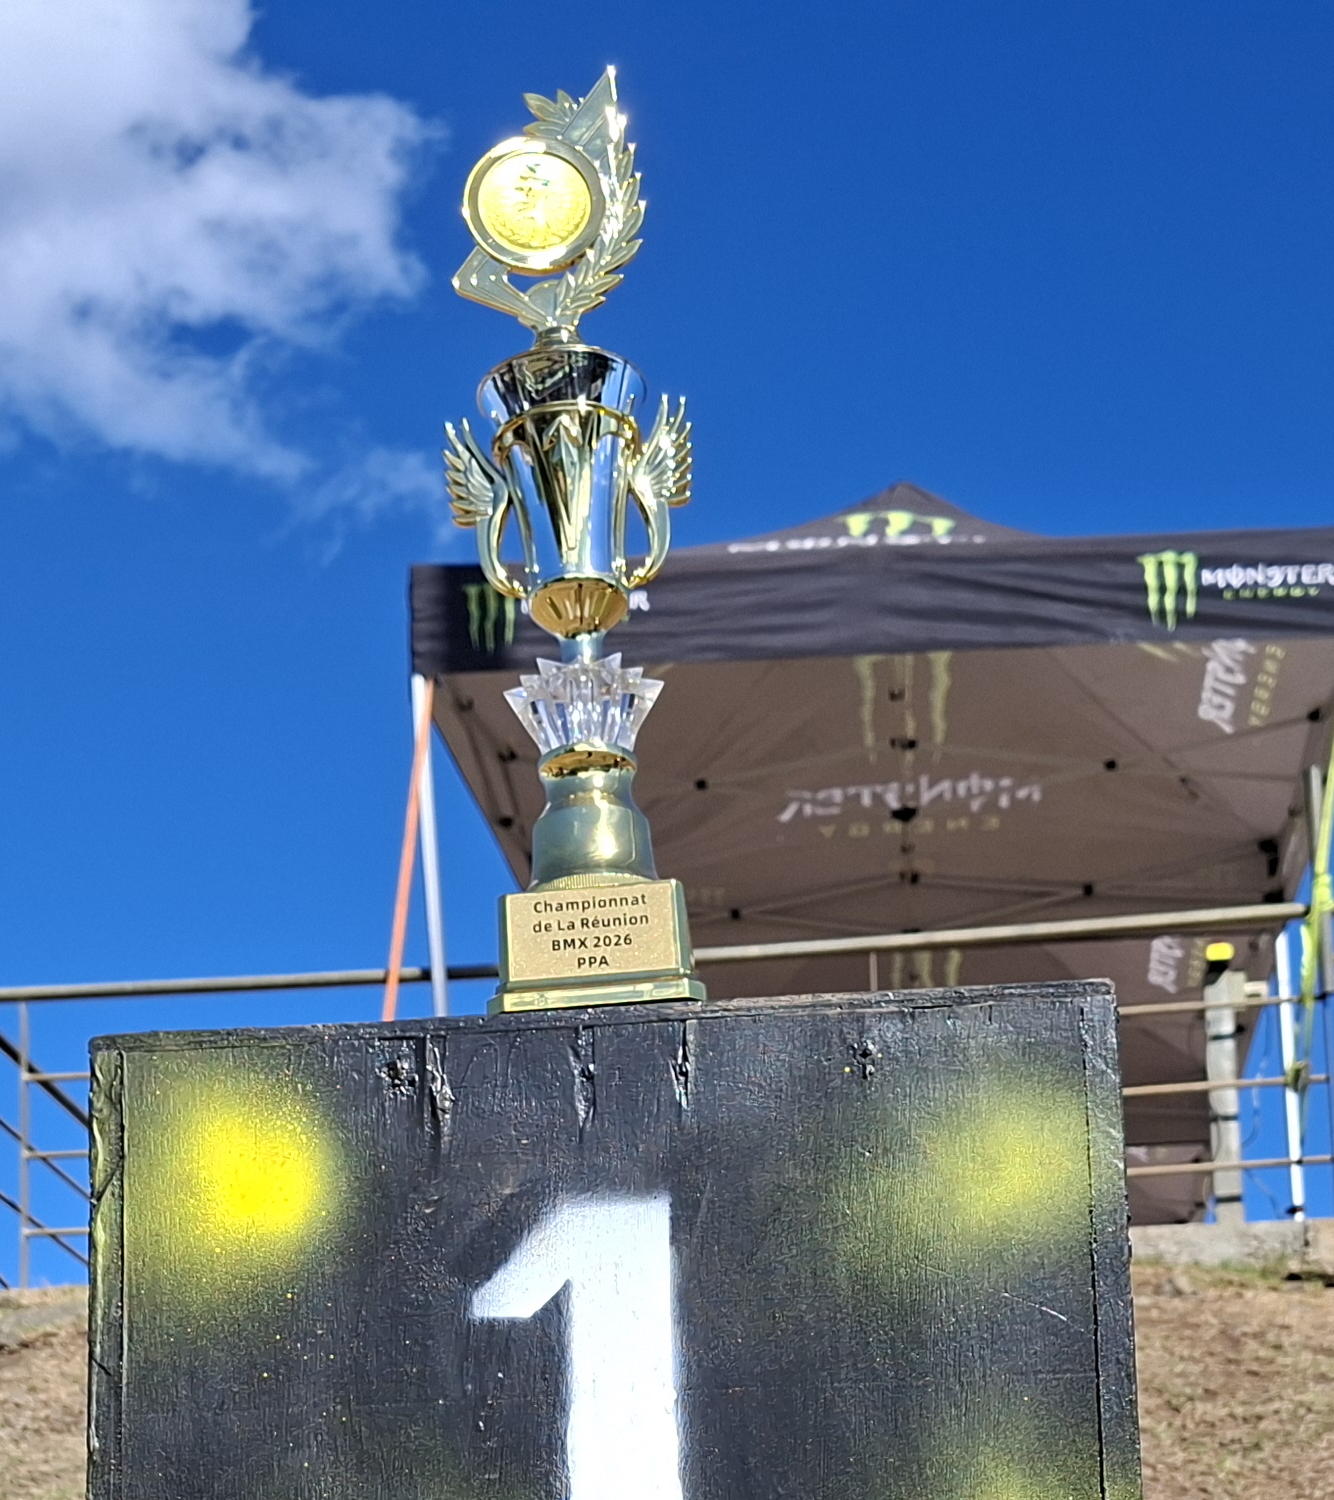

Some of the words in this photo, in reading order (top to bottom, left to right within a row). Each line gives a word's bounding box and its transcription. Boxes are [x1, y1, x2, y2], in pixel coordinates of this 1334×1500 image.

[533, 893, 647, 914] Championnat
[532, 920, 552, 933] de
[557, 918, 576, 931] La
[580, 912, 649, 930] Réunion
[552, 937, 589, 951] BMX
[593, 933, 632, 948] 2026
[577, 955, 609, 969] PPA
